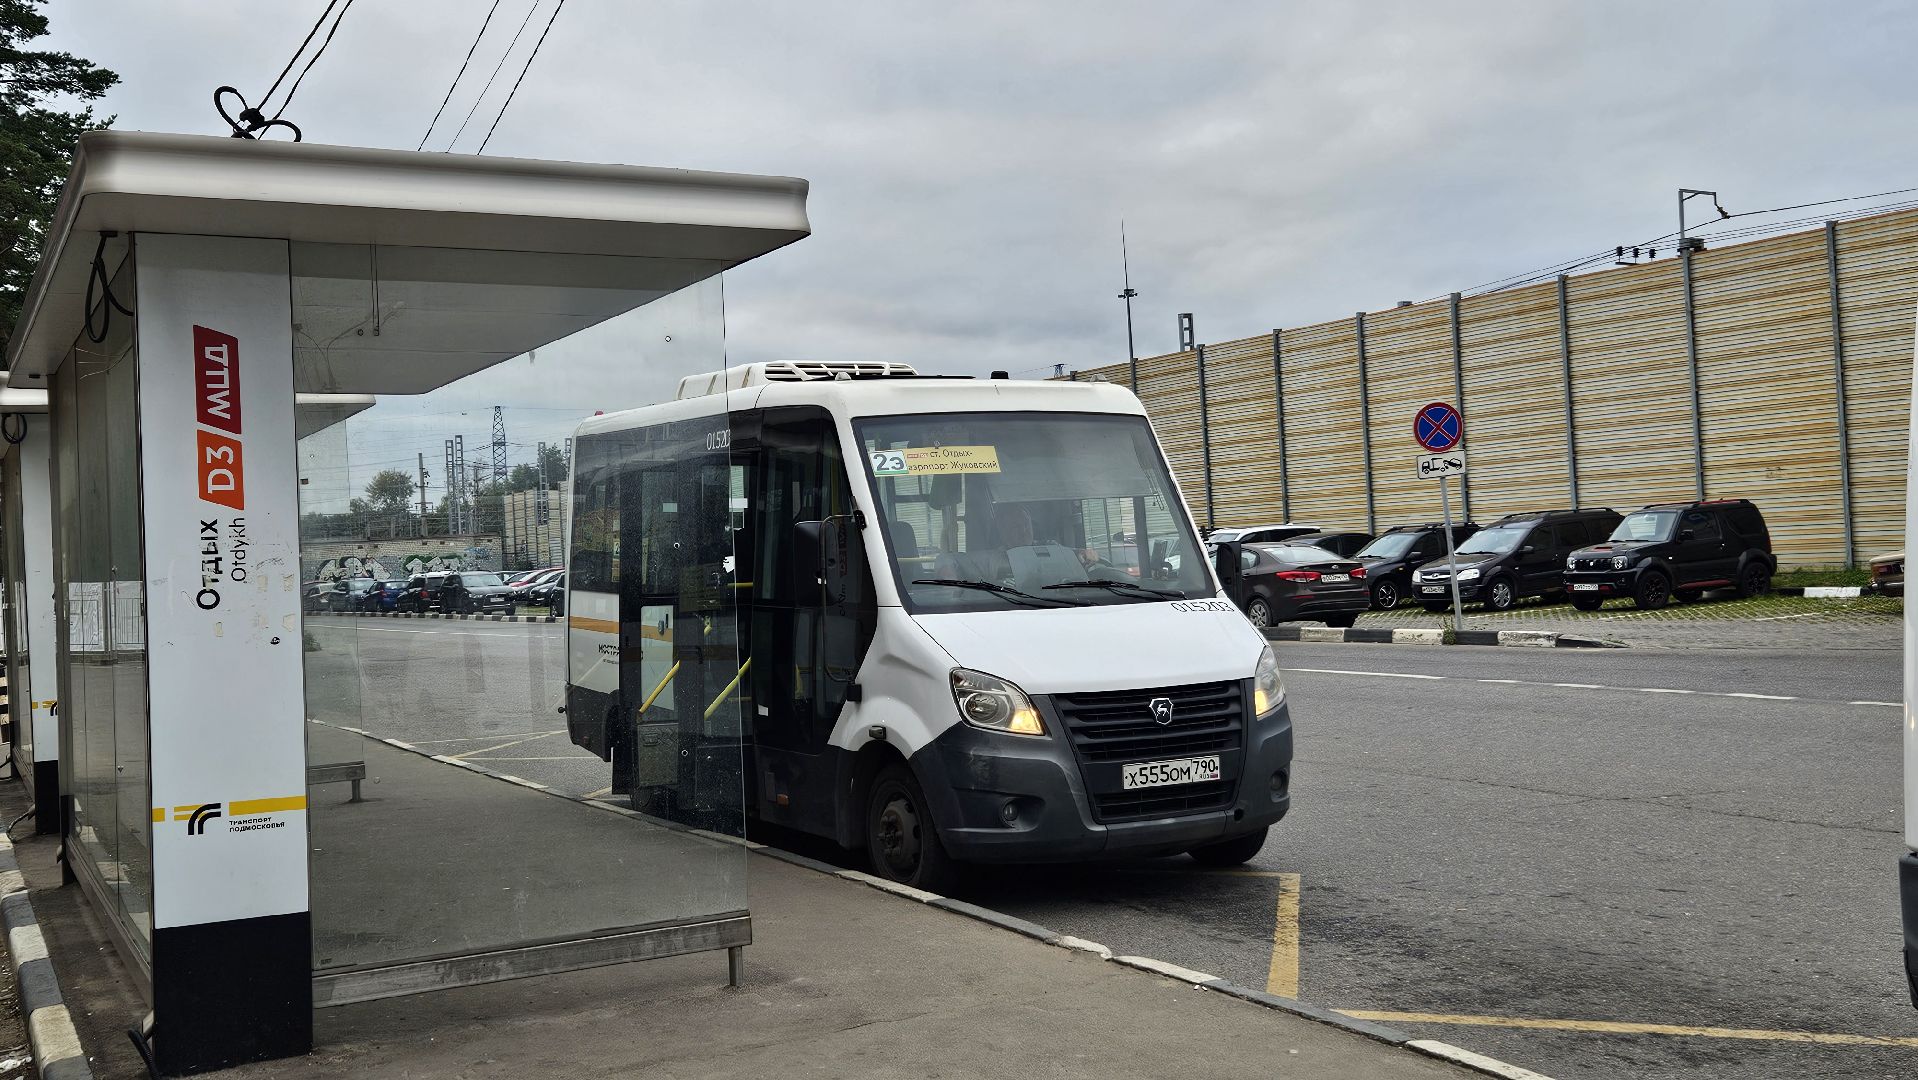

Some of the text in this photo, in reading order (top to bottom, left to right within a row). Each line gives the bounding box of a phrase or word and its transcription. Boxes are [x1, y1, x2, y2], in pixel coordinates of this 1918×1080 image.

[204, 343, 235, 494] D3 МЦД
[950, 460, 999, 471] Жуковский
[228, 517, 250, 582] Otdykh
[196, 518, 223, 610] Отдых
[1170, 601, 1235, 613] 015203
[1192, 758, 1216, 775] 790
[229, 817, 272, 826] ТРАНСПОРТ
[229, 821, 285, 833] ПОДМОСКОВЬЯ
